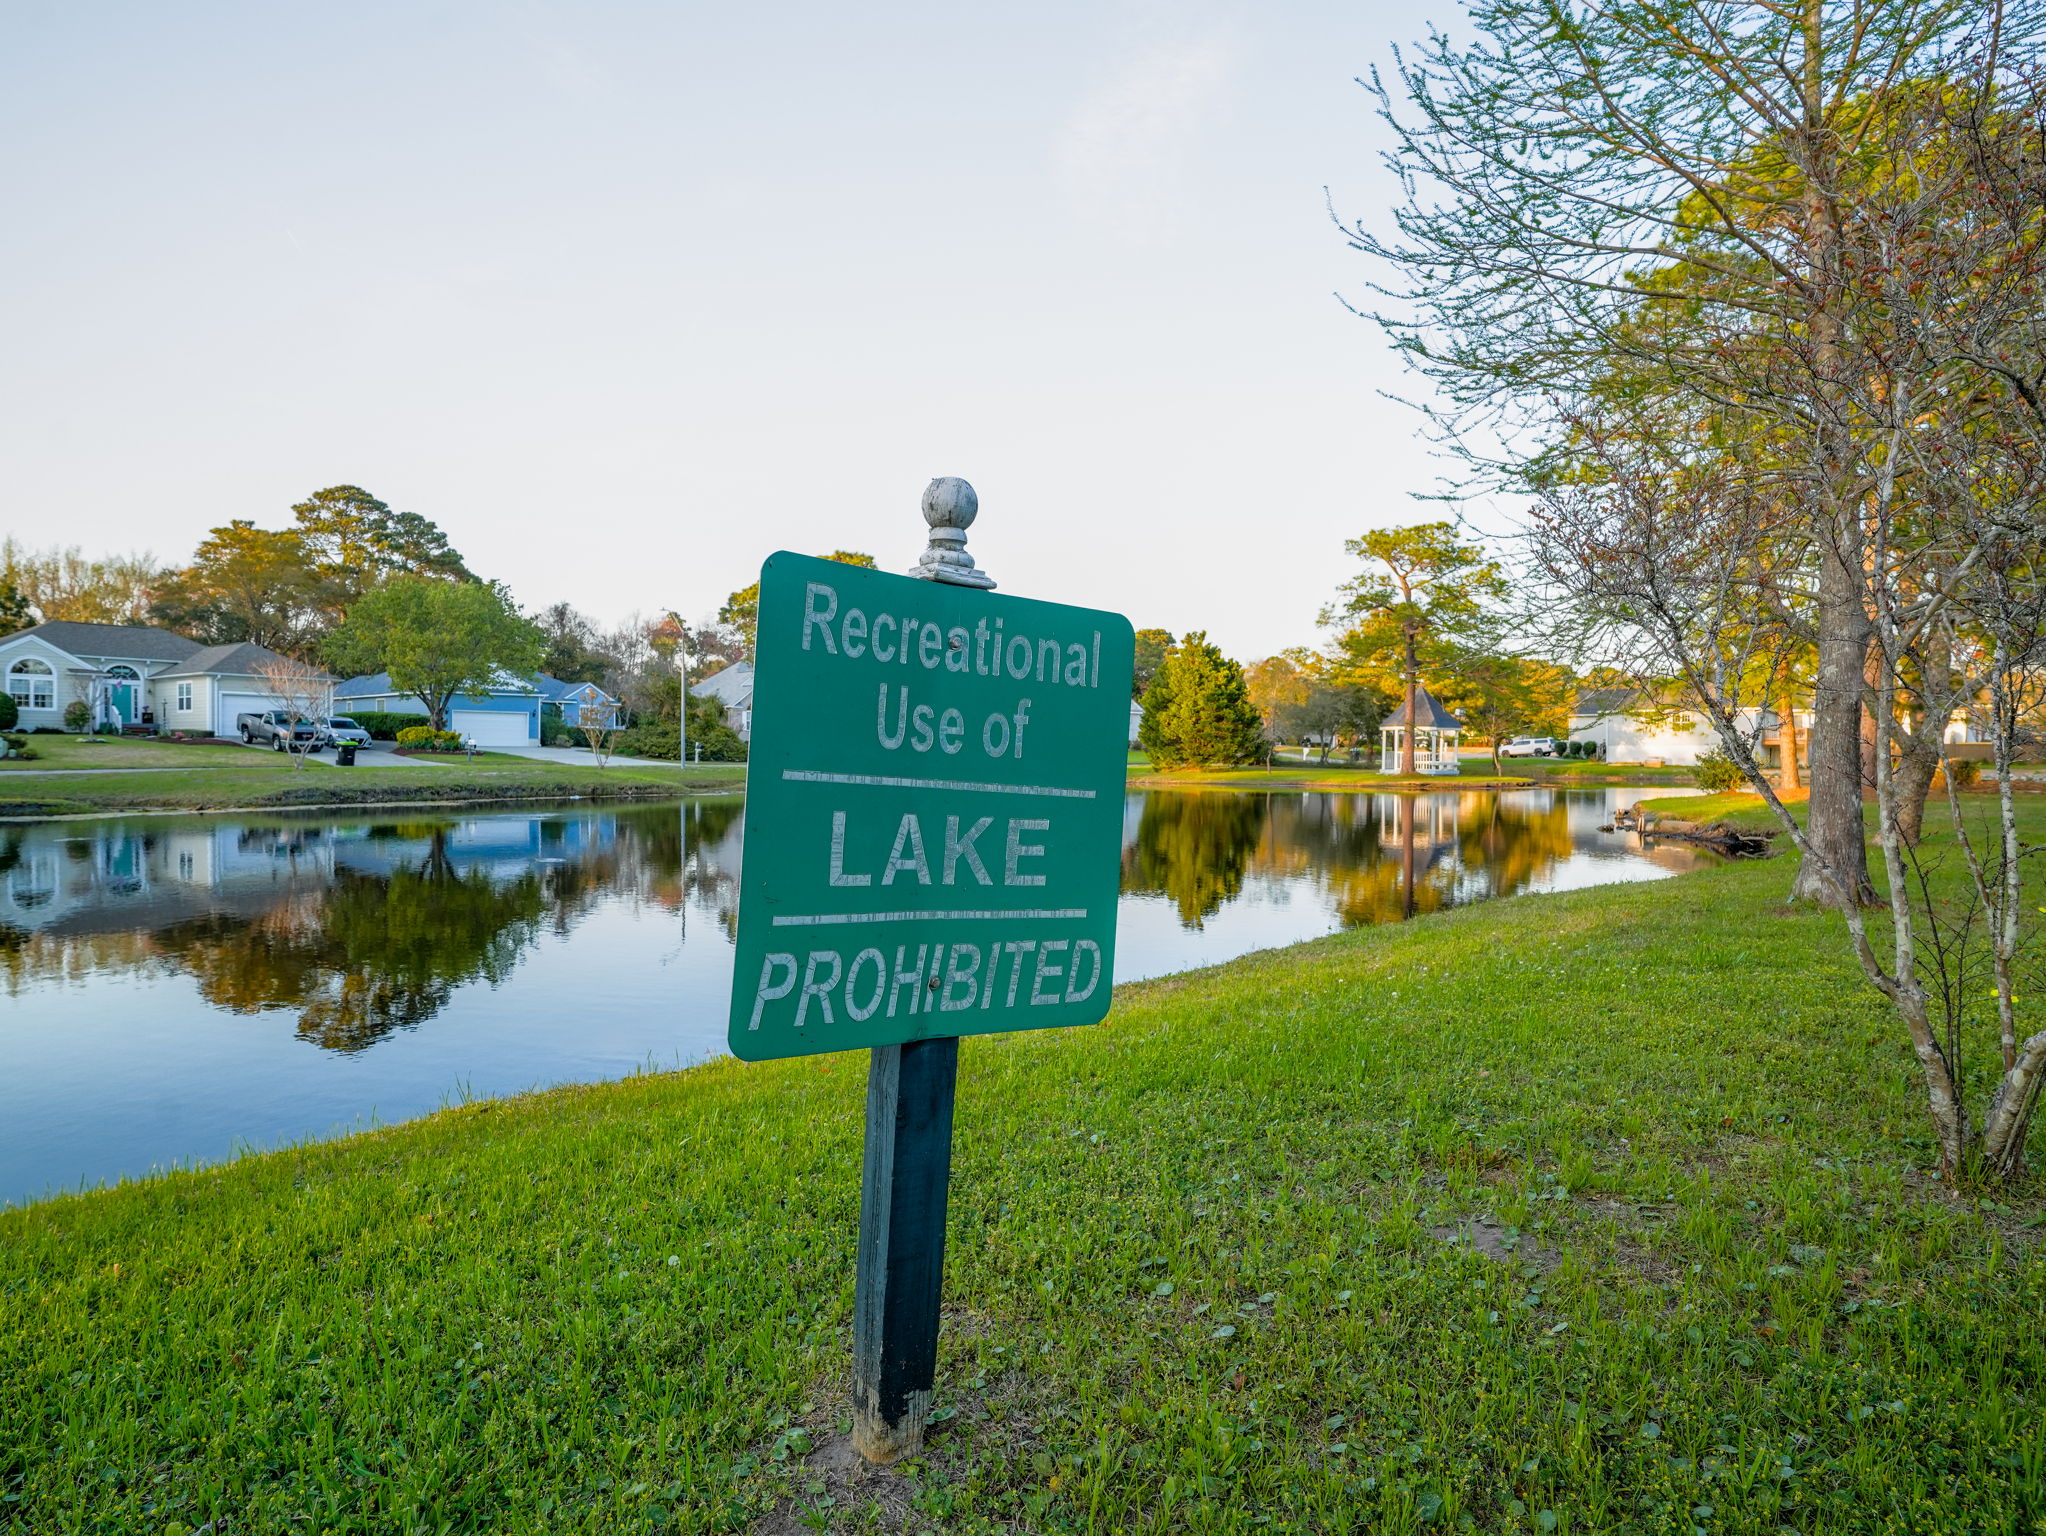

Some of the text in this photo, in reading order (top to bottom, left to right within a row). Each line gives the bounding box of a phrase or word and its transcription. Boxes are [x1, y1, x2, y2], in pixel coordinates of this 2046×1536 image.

[801, 582, 1100, 688] Recreational
[877, 683, 1031, 758] Use of
[829, 811, 1050, 886] LAKE
[748, 940, 1101, 1031] PROHIBITED
